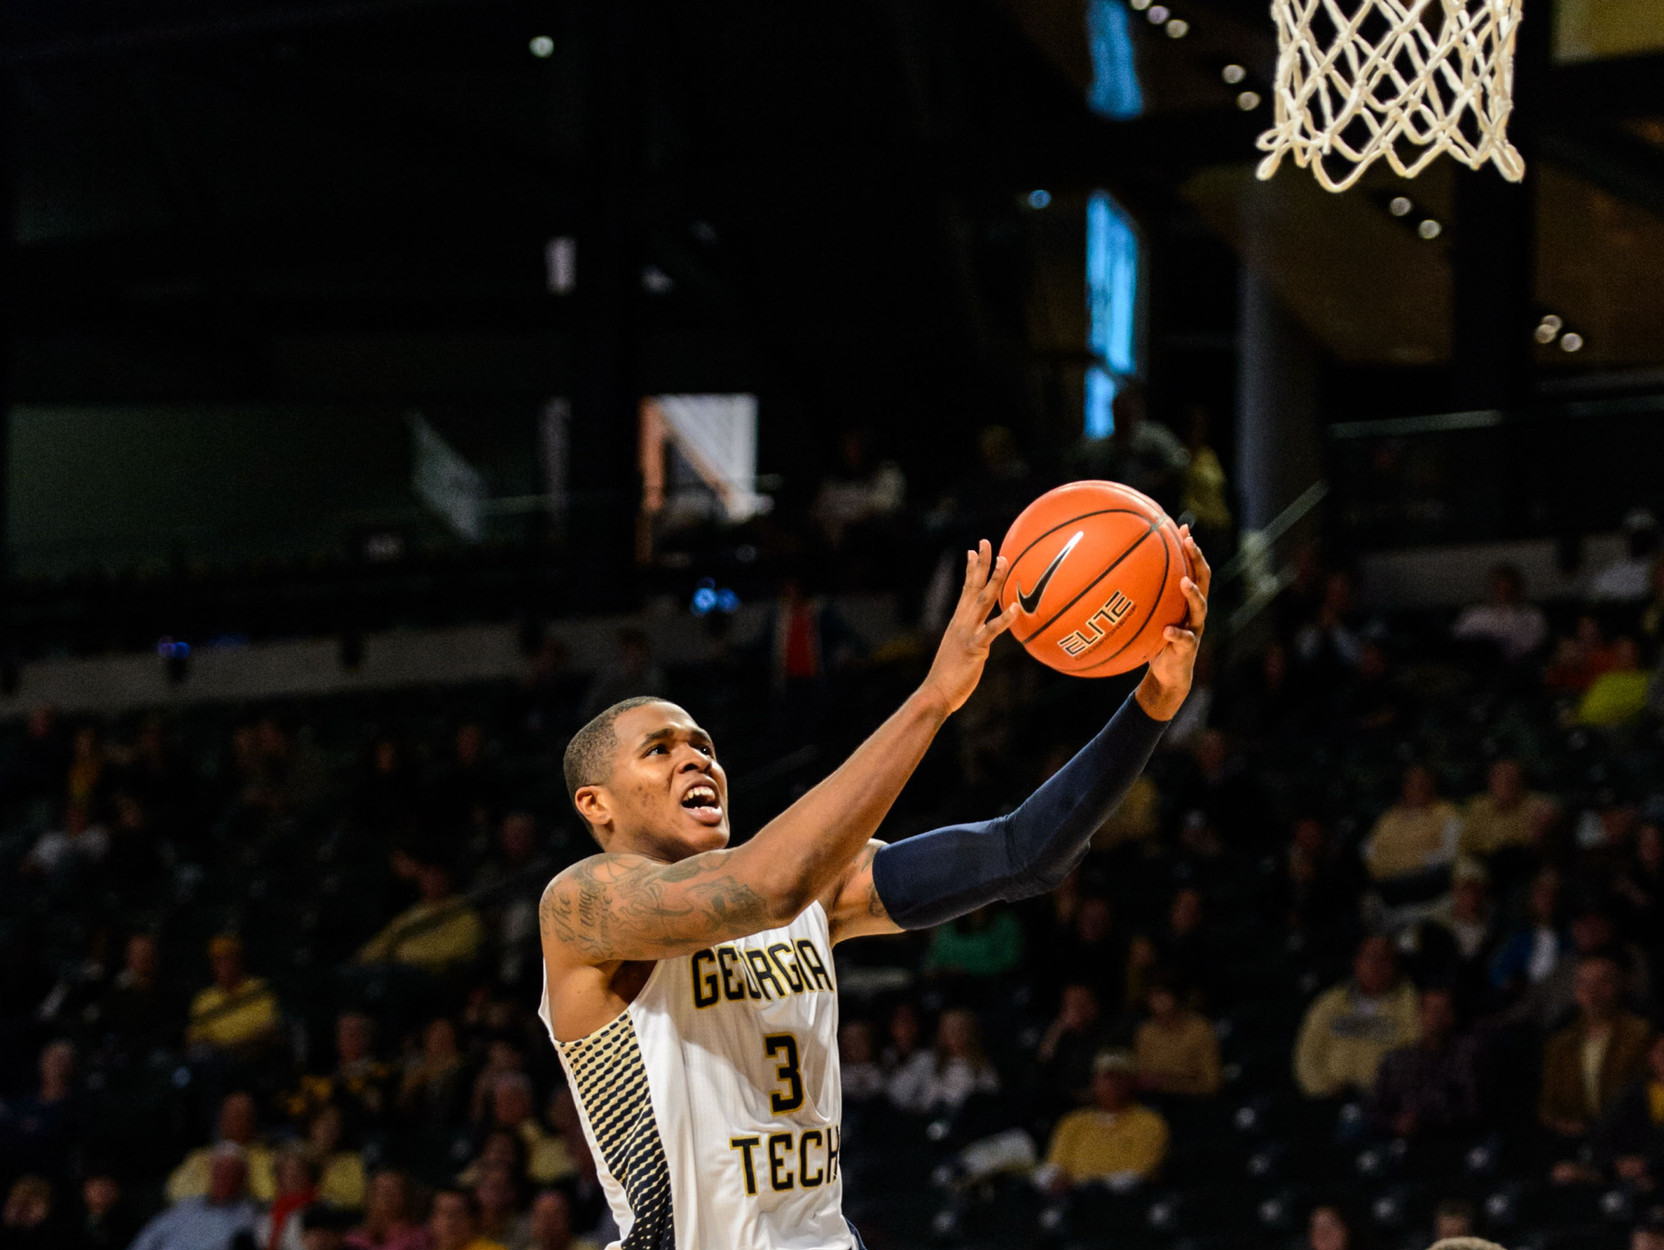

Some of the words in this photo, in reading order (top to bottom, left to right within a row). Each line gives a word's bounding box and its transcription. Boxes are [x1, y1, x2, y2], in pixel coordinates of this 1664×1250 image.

[1057, 590, 1133, 657] ELITE
[764, 1031, 805, 1116] 3
[729, 1122, 840, 1196] TECH
